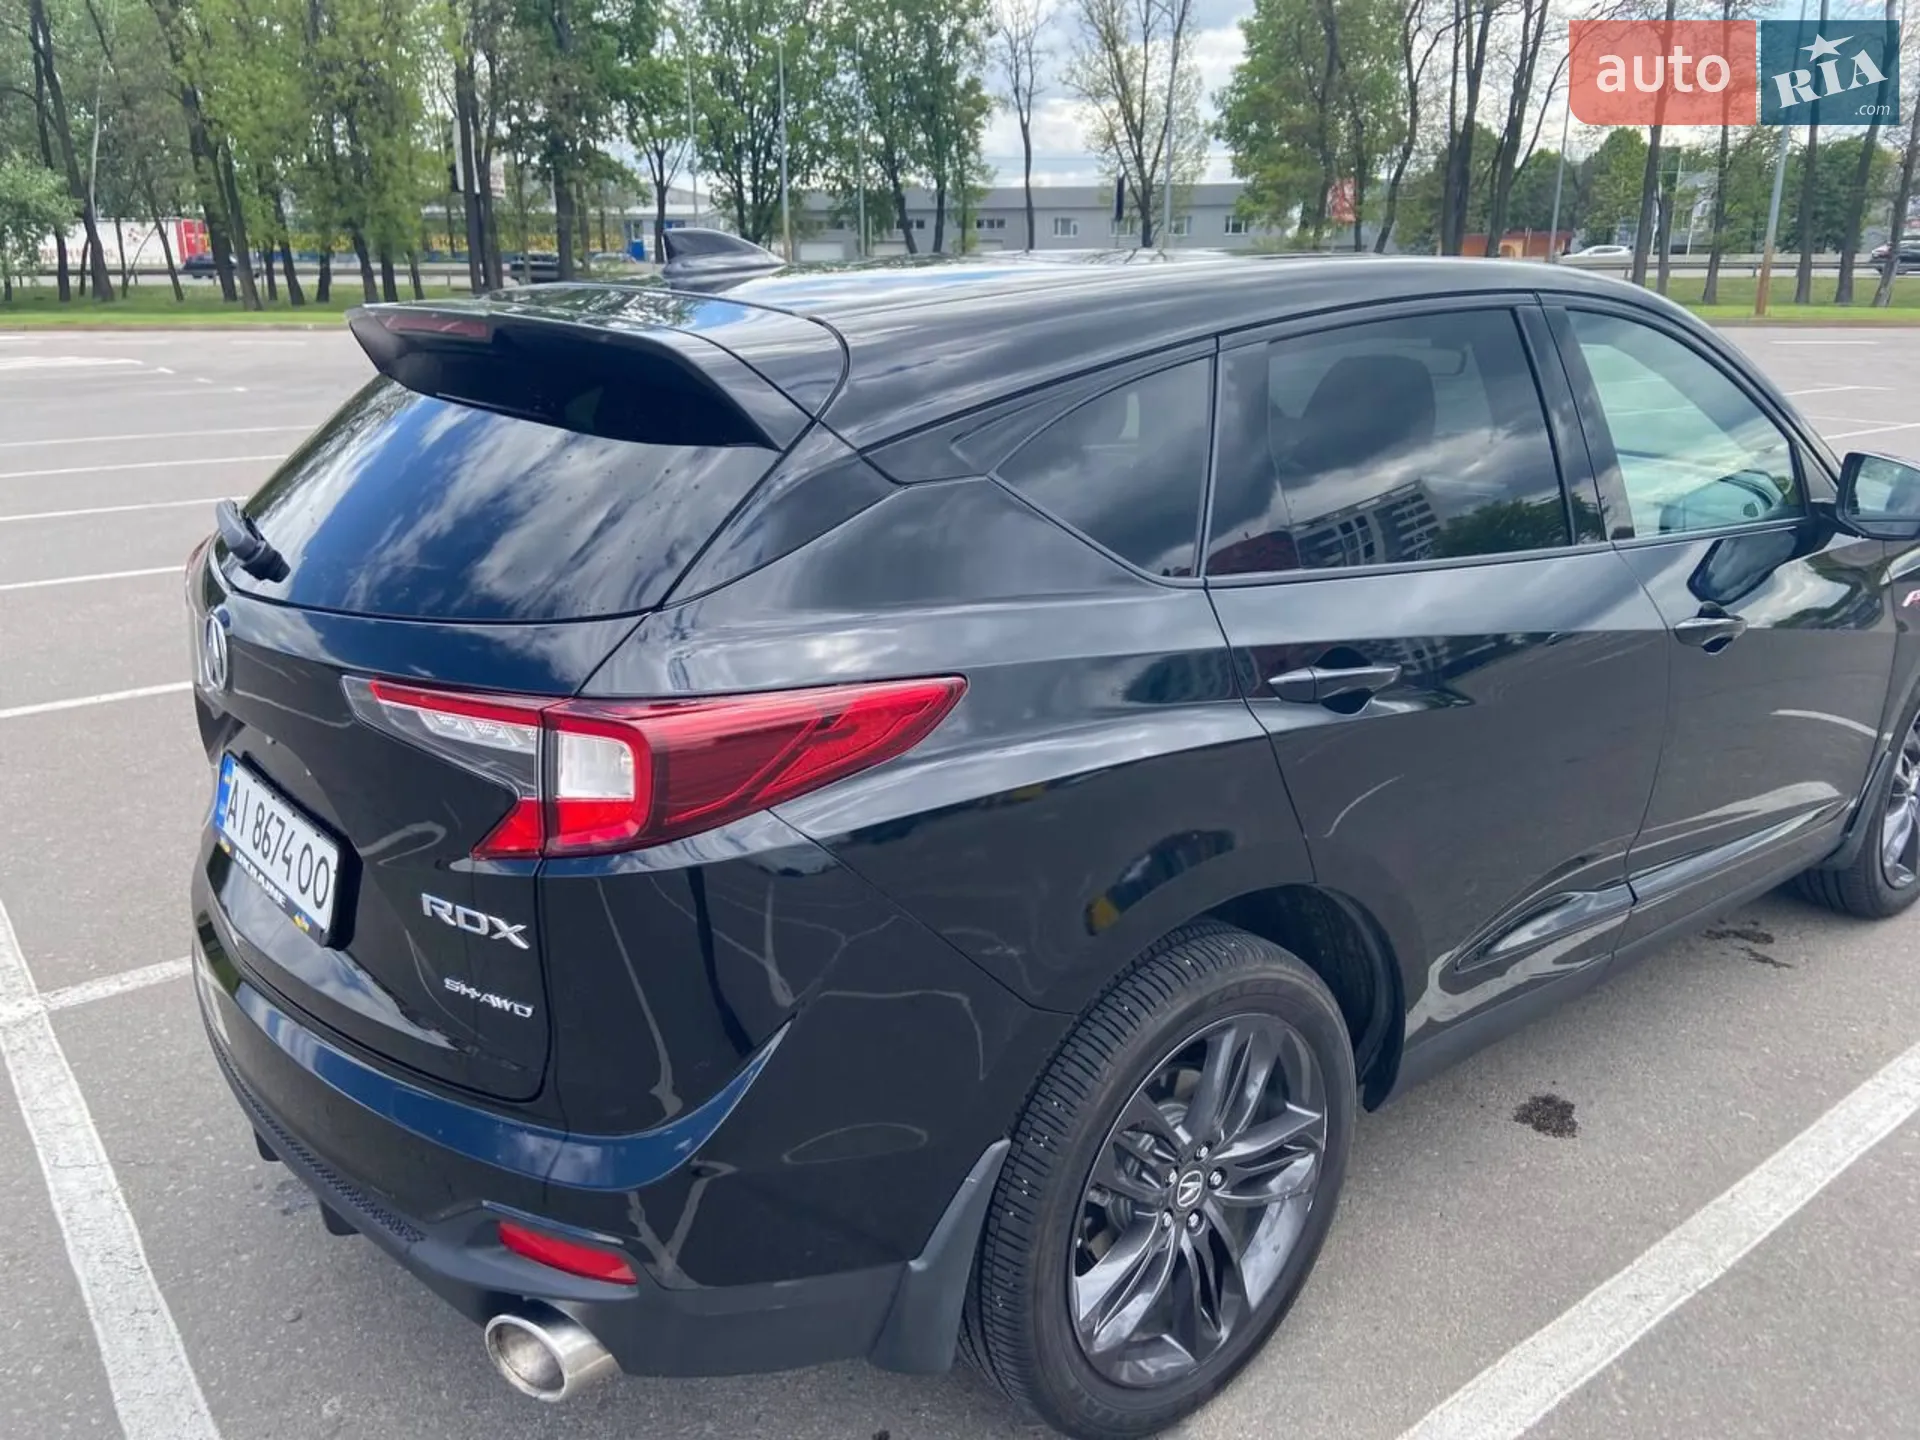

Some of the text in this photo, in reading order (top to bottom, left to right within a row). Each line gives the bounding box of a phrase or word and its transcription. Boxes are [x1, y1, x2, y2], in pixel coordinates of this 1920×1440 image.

[226, 780, 250, 837] AI
[252, 801, 296, 882] 8674
[235, 850, 287, 908] UKRAINE
[421, 892, 530, 950] RDX
[444, 977, 535, 1018] SH-AWD
